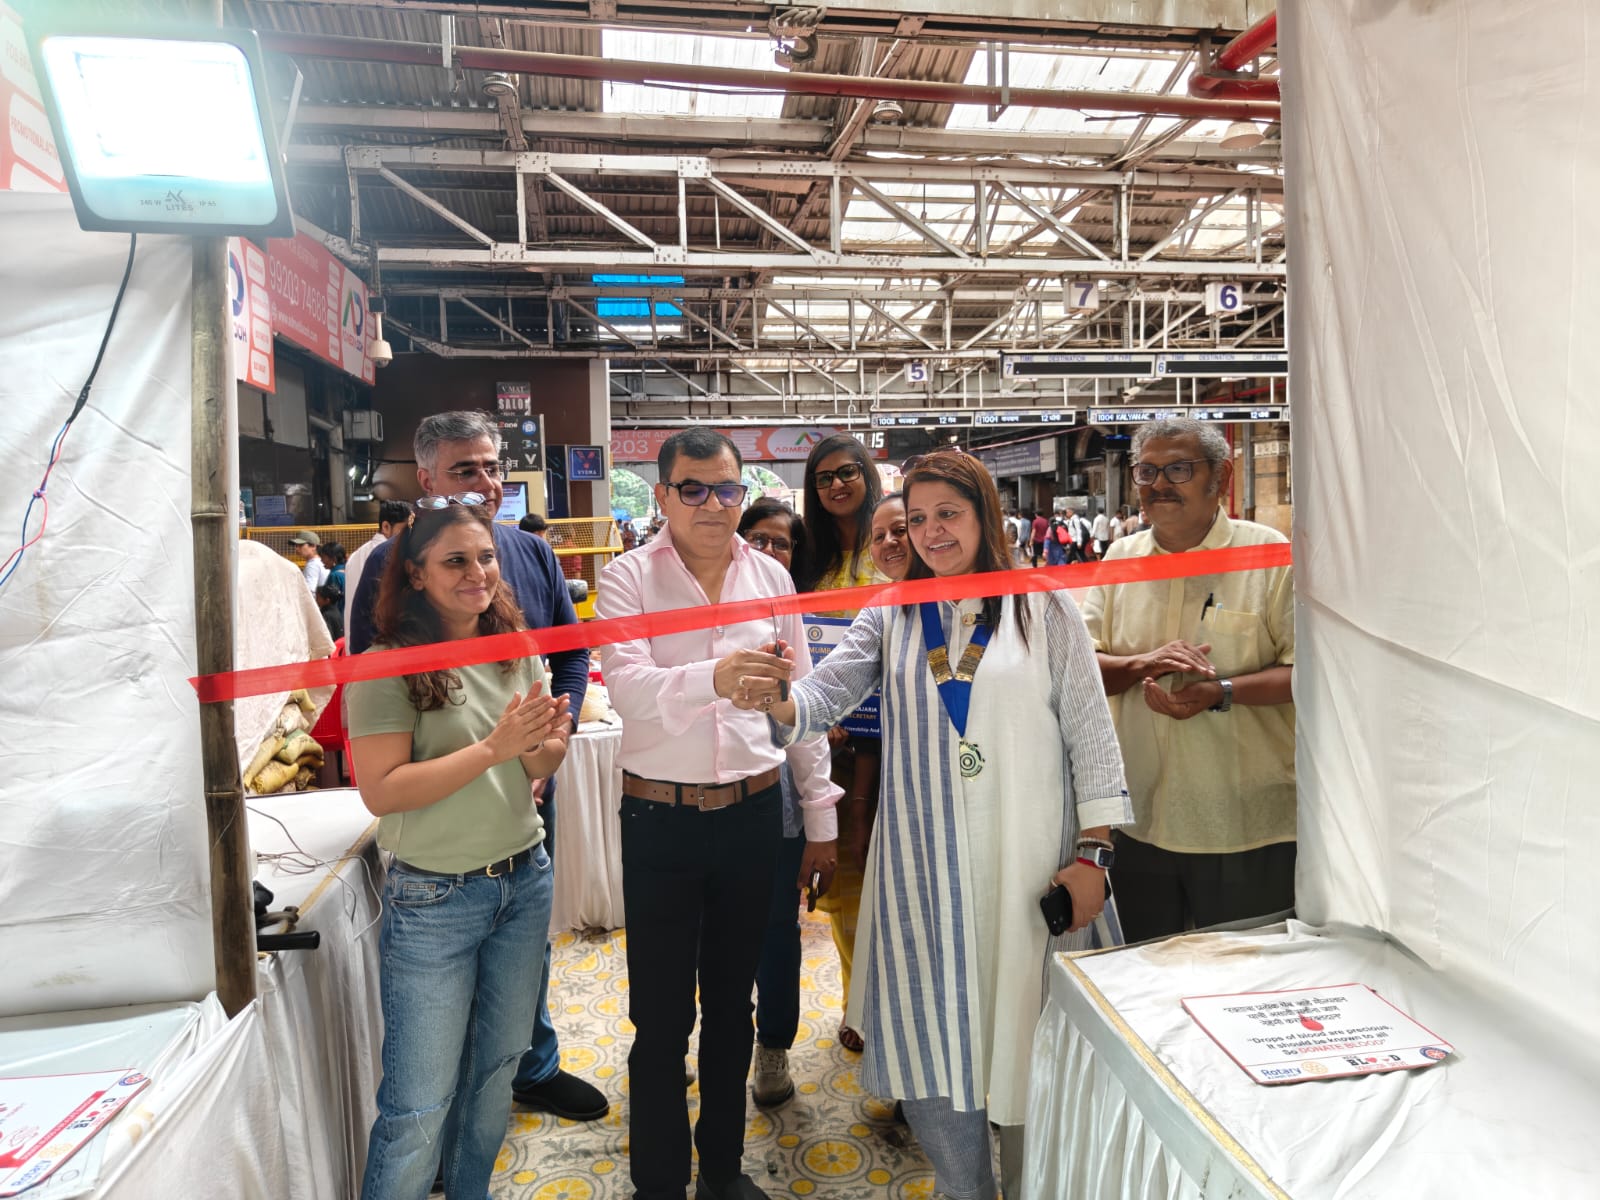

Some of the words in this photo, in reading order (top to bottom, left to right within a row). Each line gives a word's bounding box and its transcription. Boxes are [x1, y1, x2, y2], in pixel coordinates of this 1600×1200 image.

[1074, 283, 1094, 306] 7
[1220, 285, 1238, 309] 6
[911, 362, 925, 380] 5
[1005, 363, 1012, 375] 7
[1158, 362, 1165, 373] 6
[871, 432, 885, 449] 15
[1296, 1031, 1327, 1039] blood
[1276, 1040, 1313, 1049] should
[1327, 1035, 1362, 1043] known
[1298, 1044, 1344, 1054] DONATE
[1260, 1067, 1302, 1077] Rotary
